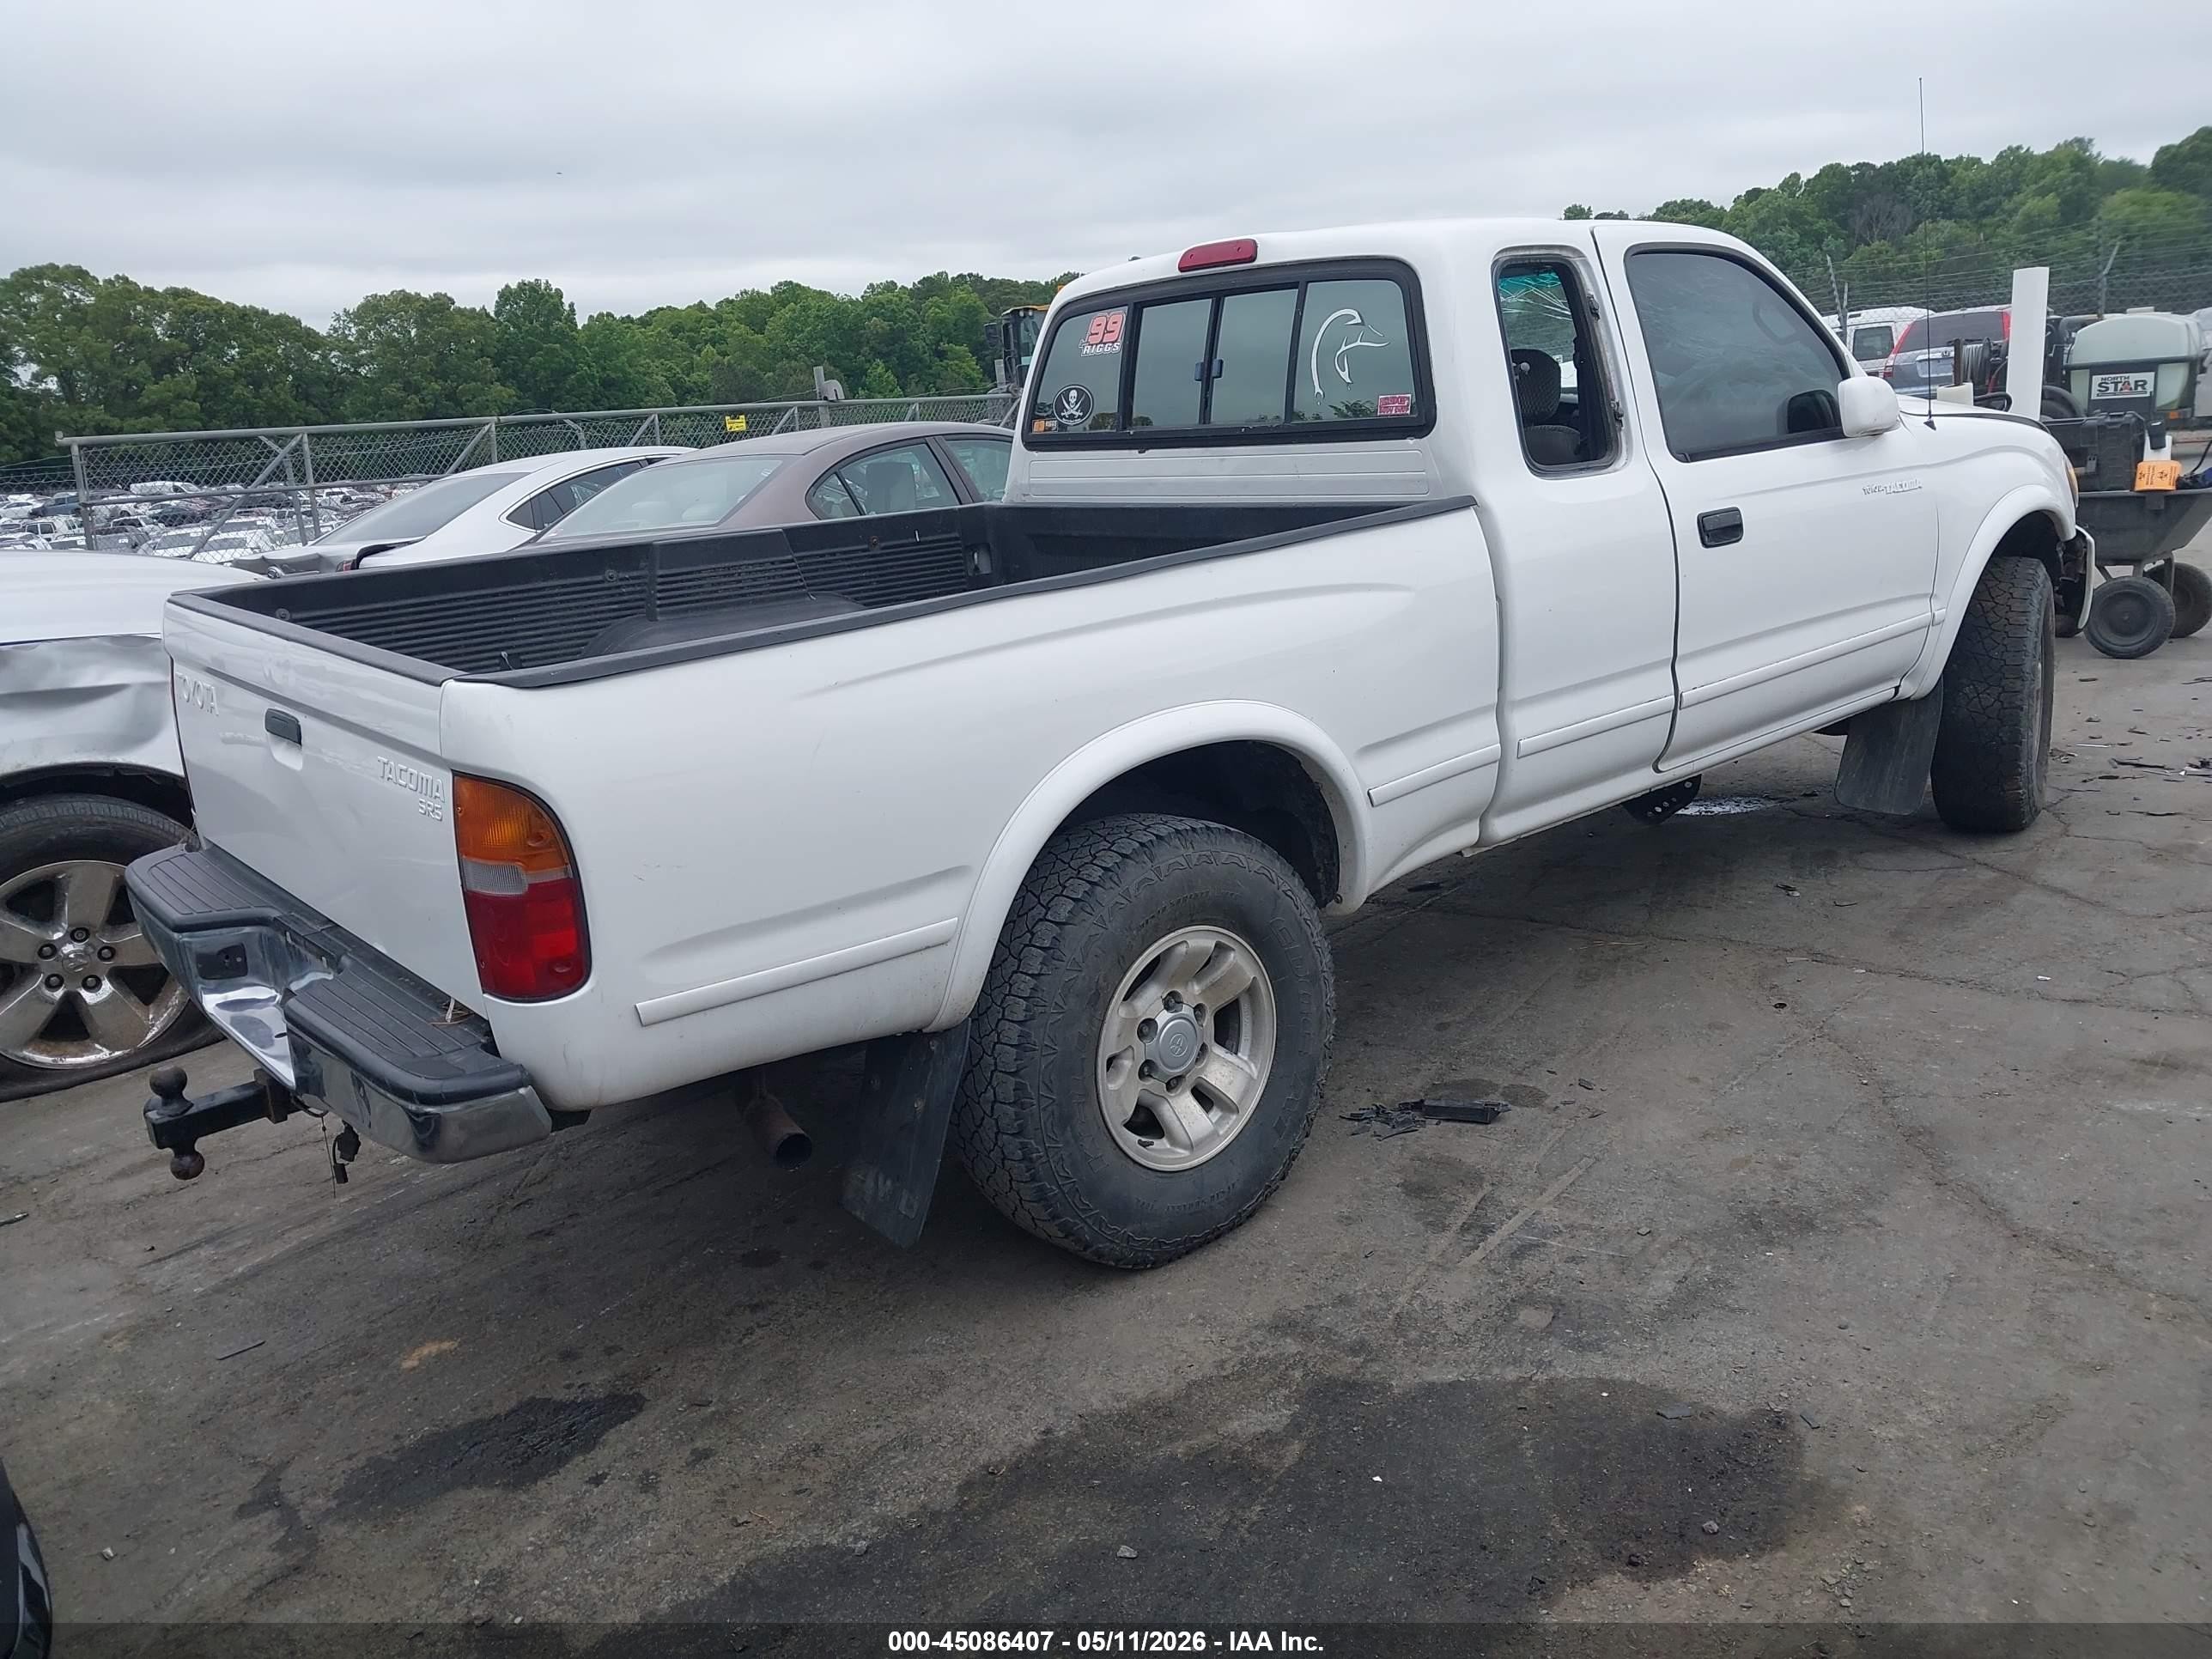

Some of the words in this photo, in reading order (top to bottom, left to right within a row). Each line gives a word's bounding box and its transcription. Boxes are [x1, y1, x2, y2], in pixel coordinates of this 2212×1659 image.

[1085, 314, 1124, 343] 99
[2097, 379, 2148, 392] STAR
[378, 757, 445, 804] TACOMA
